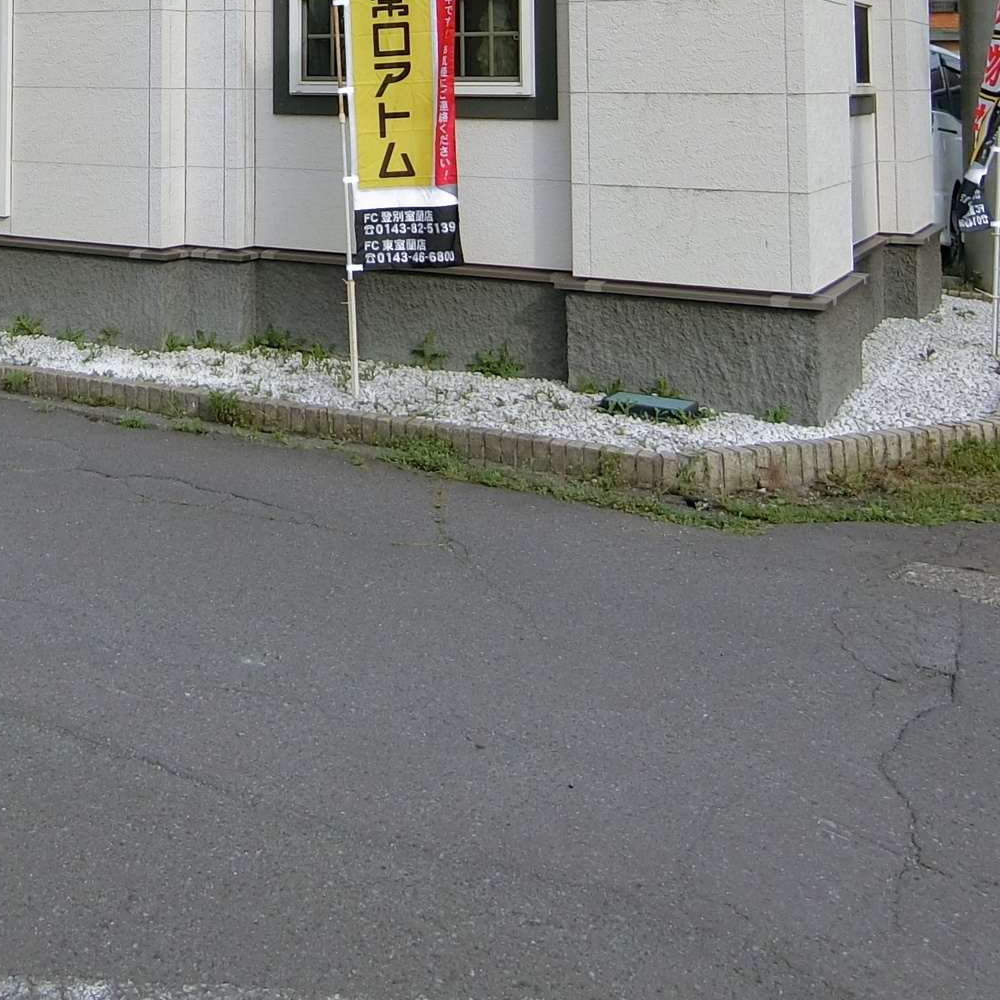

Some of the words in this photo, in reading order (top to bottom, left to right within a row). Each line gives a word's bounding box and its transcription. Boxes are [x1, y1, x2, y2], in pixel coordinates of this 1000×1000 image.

[364, 213, 378, 223] FC
[375, 221, 456, 235] 0143-82-5139
[364, 240, 380, 251] FC
[382, 239, 427, 251] 東室蘭店
